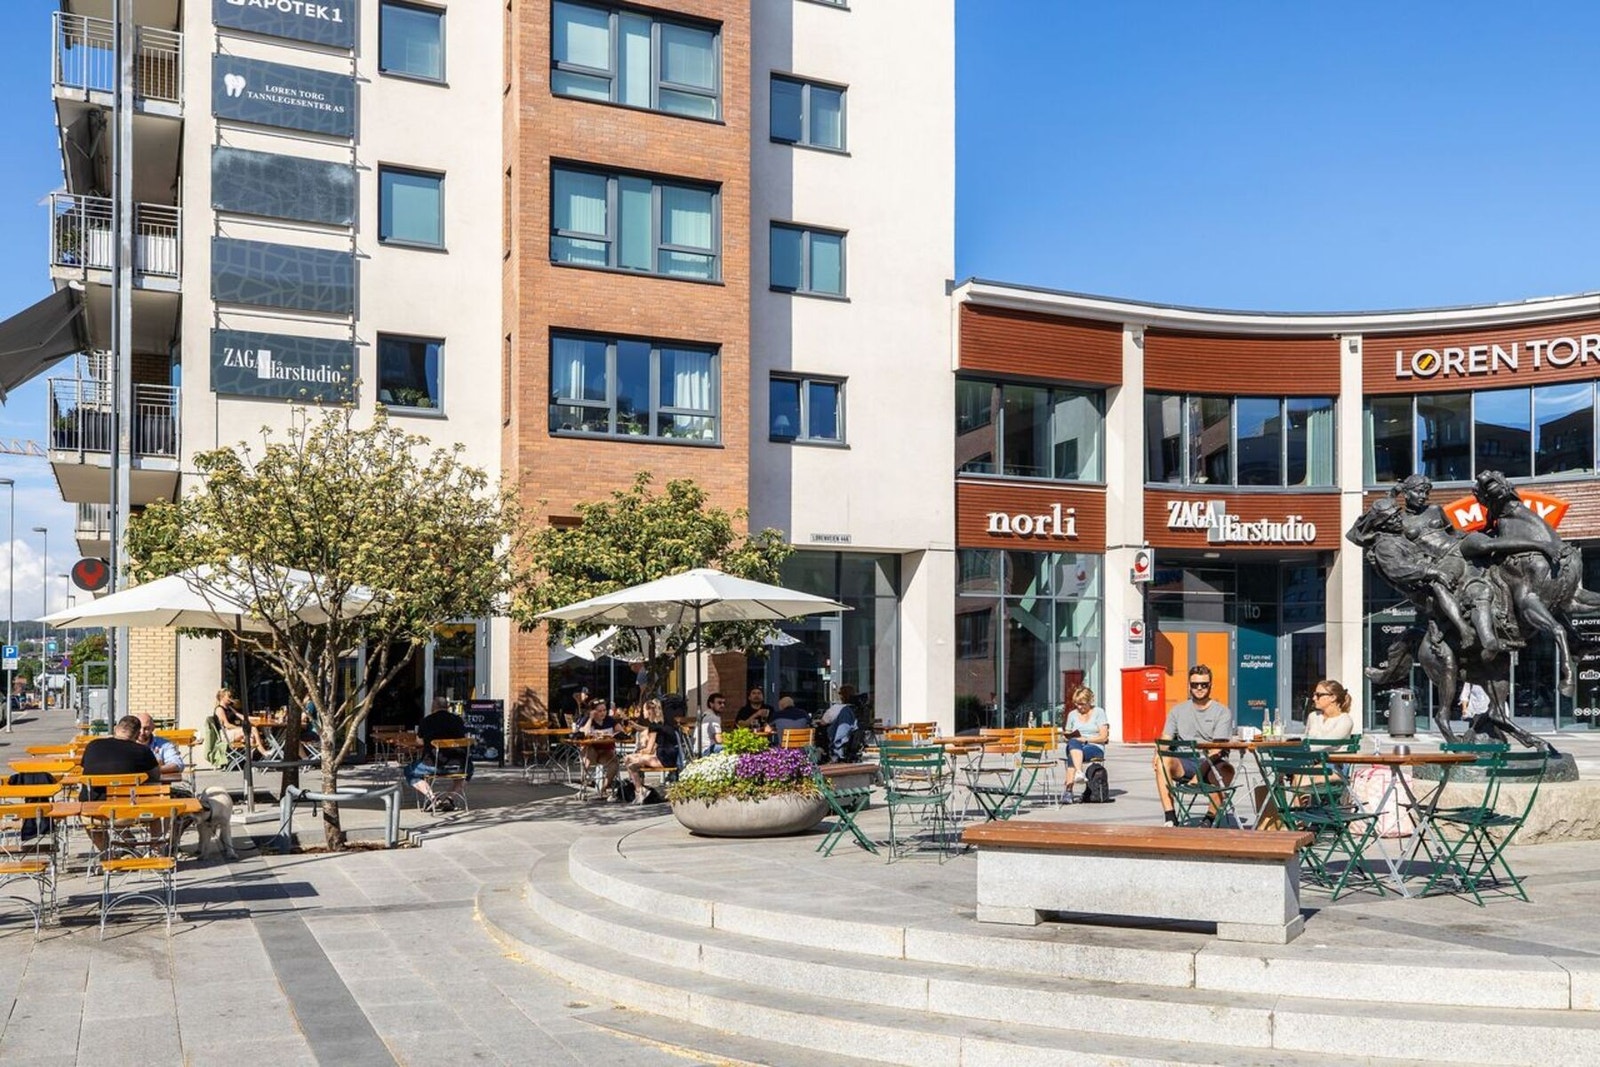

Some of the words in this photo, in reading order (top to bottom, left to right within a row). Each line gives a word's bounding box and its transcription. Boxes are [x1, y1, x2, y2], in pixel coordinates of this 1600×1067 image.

[247, 0, 329, 20] APOTEK
[332, 8, 343, 22] 1
[247, 91, 332, 112] TANNLEGESENTER
[299, 90, 325, 101] TORG
[985, 502, 1079, 537] norli
[1166, 500, 1219, 529] ZAGA
[1218, 514, 1317, 542] Hårstudio
[5, 647, 15, 657] P
[1240, 661, 1274, 669] muligheter
